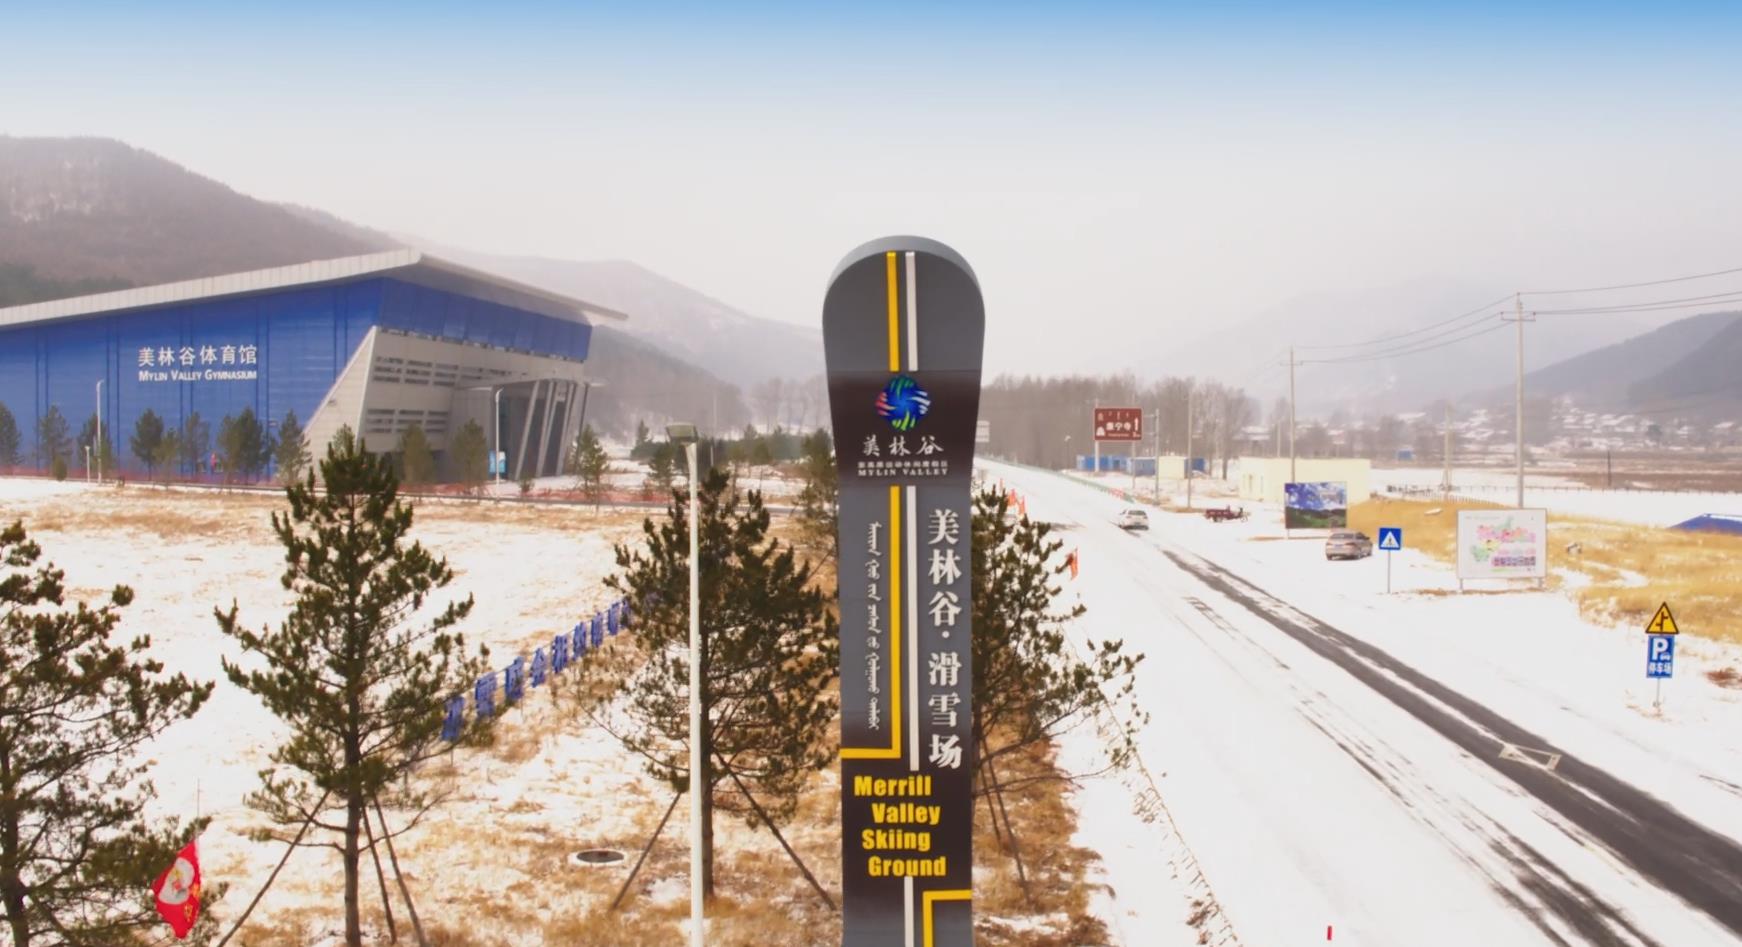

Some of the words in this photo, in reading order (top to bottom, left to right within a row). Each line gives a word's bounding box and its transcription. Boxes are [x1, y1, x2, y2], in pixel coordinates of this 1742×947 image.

[138, 345, 257, 367] 美林谷体育馆
[863, 434, 944, 457] 美林谷
[1652, 638, 1668, 660] P
[854, 775, 931, 796] Merrill
[871, 803, 941, 825] Valley
[862, 829, 931, 852] Skiing
[868, 855, 947, 876] Ground
